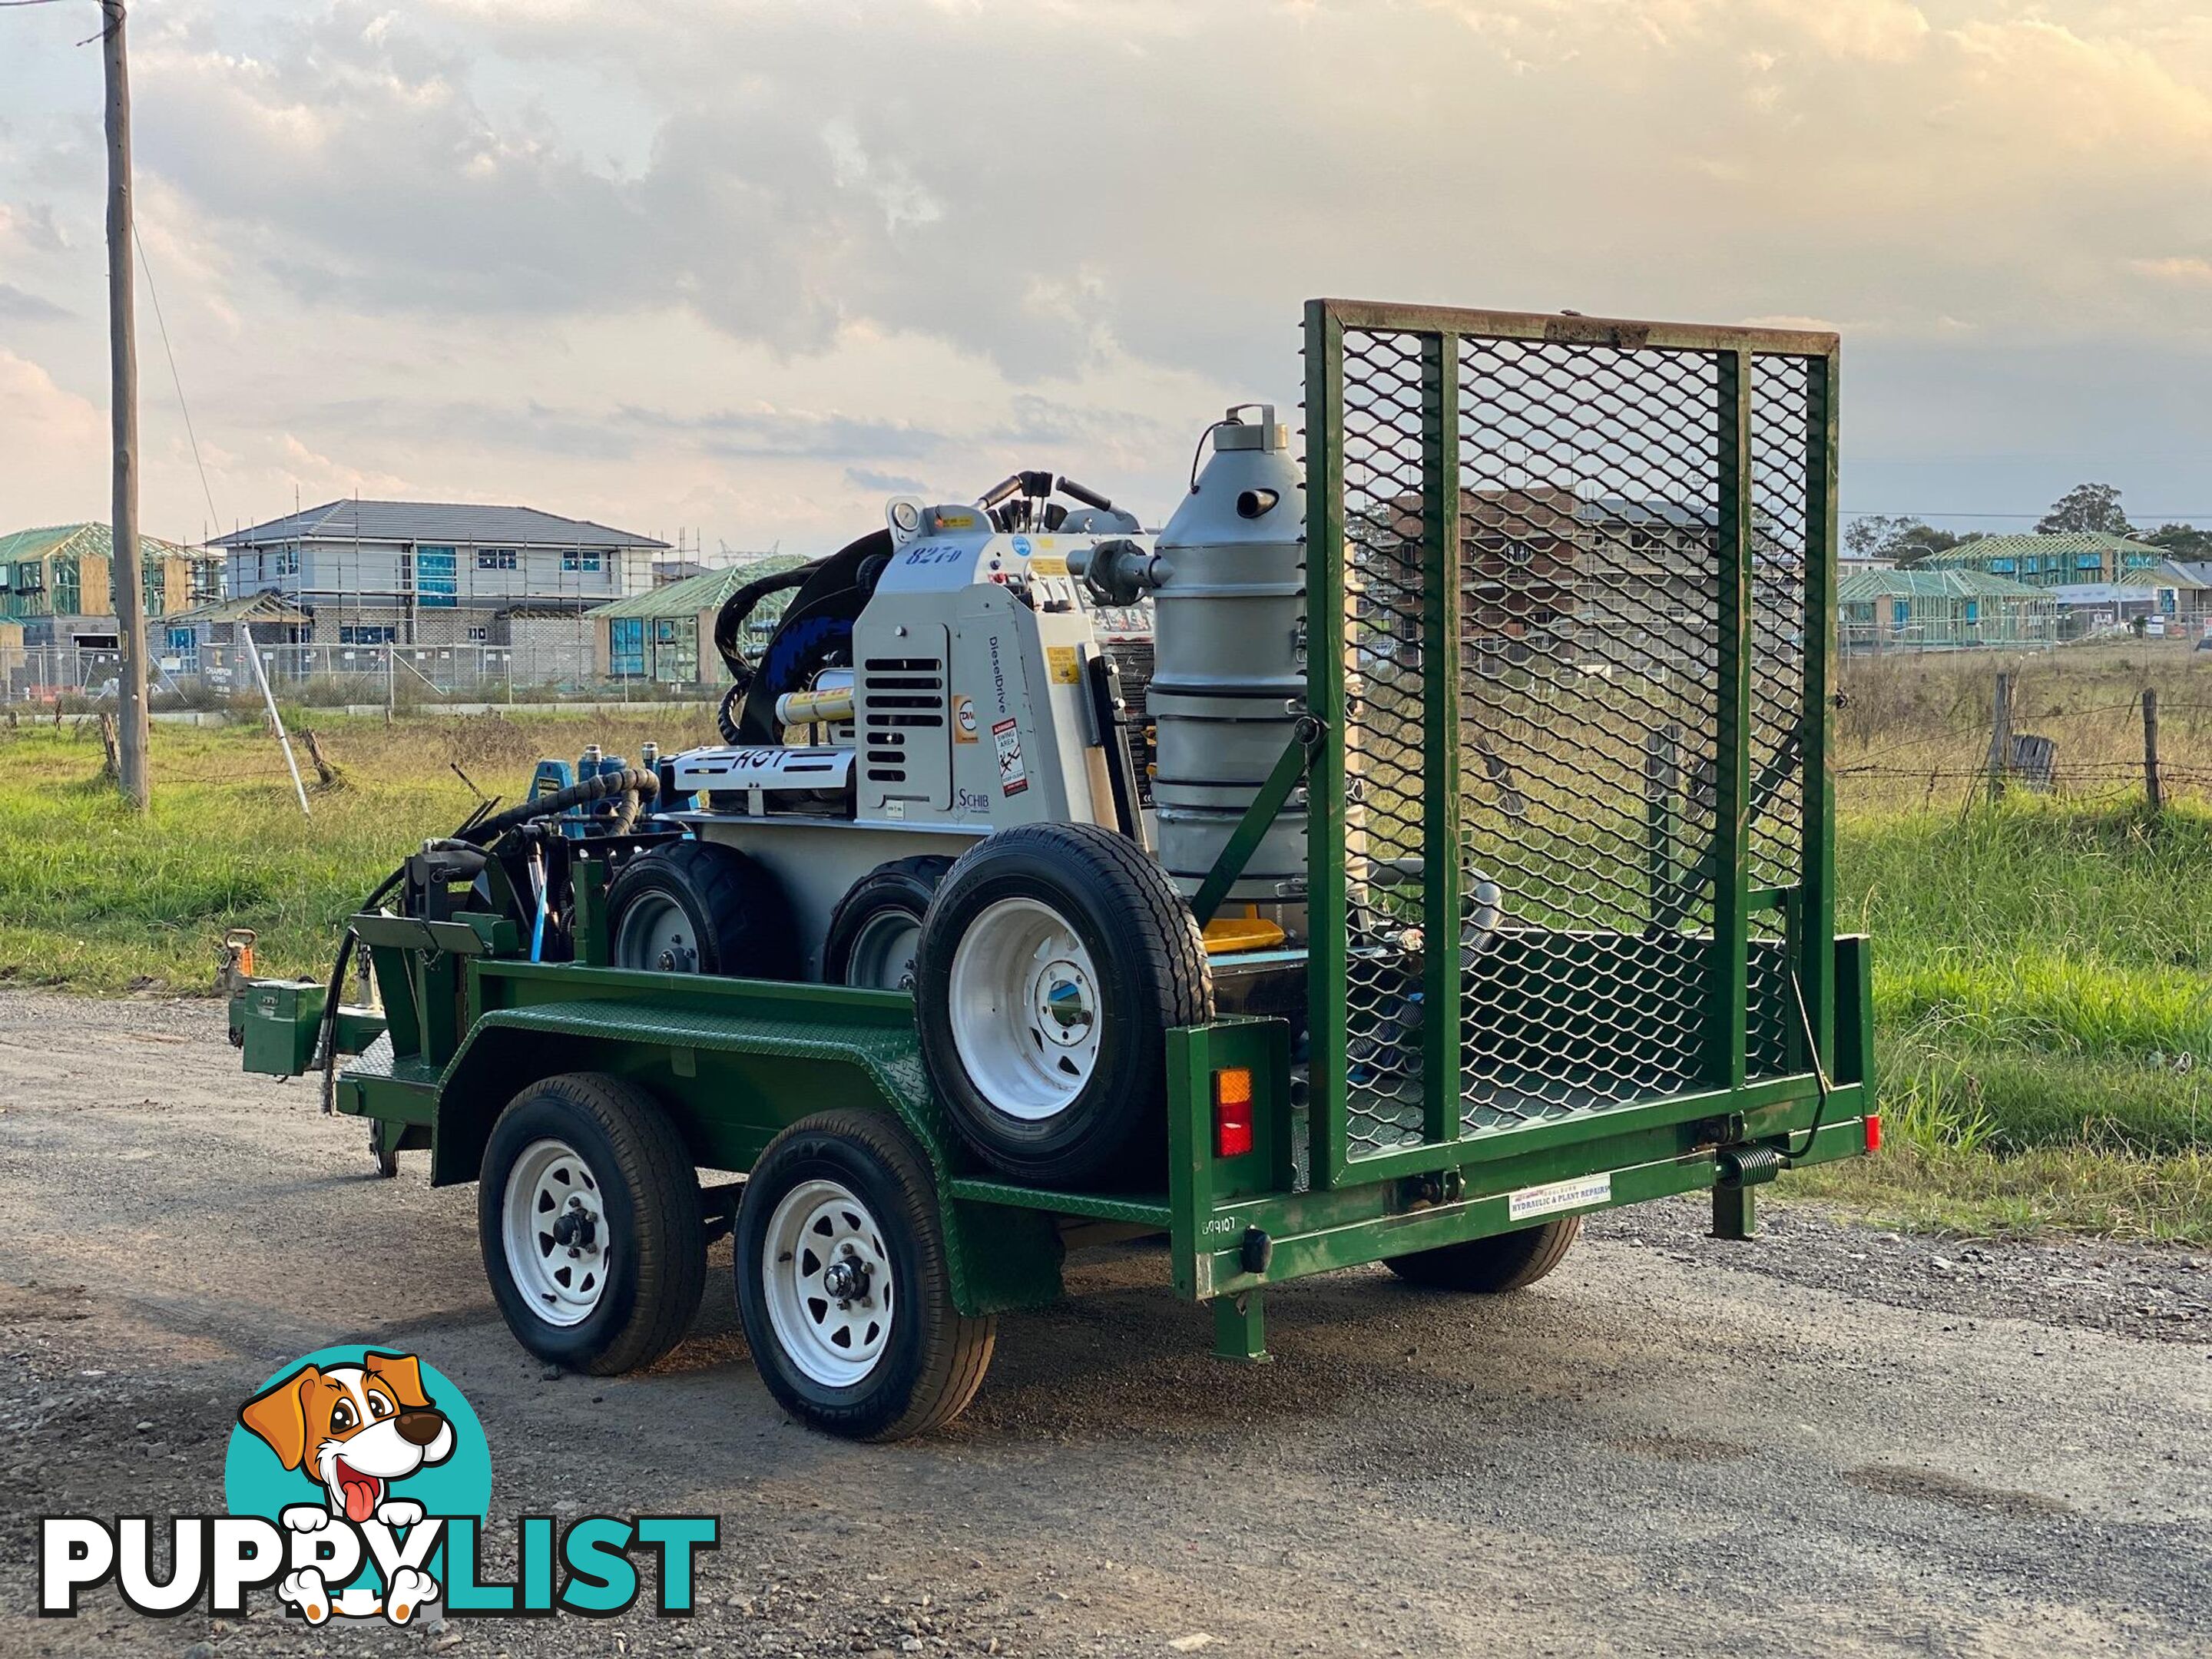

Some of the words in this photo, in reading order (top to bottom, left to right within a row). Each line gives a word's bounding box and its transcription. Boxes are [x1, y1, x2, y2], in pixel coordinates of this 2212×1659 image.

[989, 636, 1006, 714] DieselDrive
[998, 730, 1015, 742] SWING
[1000, 738, 1015, 747] AREA
[732, 750, 788, 769] HOT
[1512, 1197, 1551, 1212] HYDRAULIC
[1558, 1191, 1580, 1203] PLANT
[1581, 1185, 1610, 1198] REPAIRS
